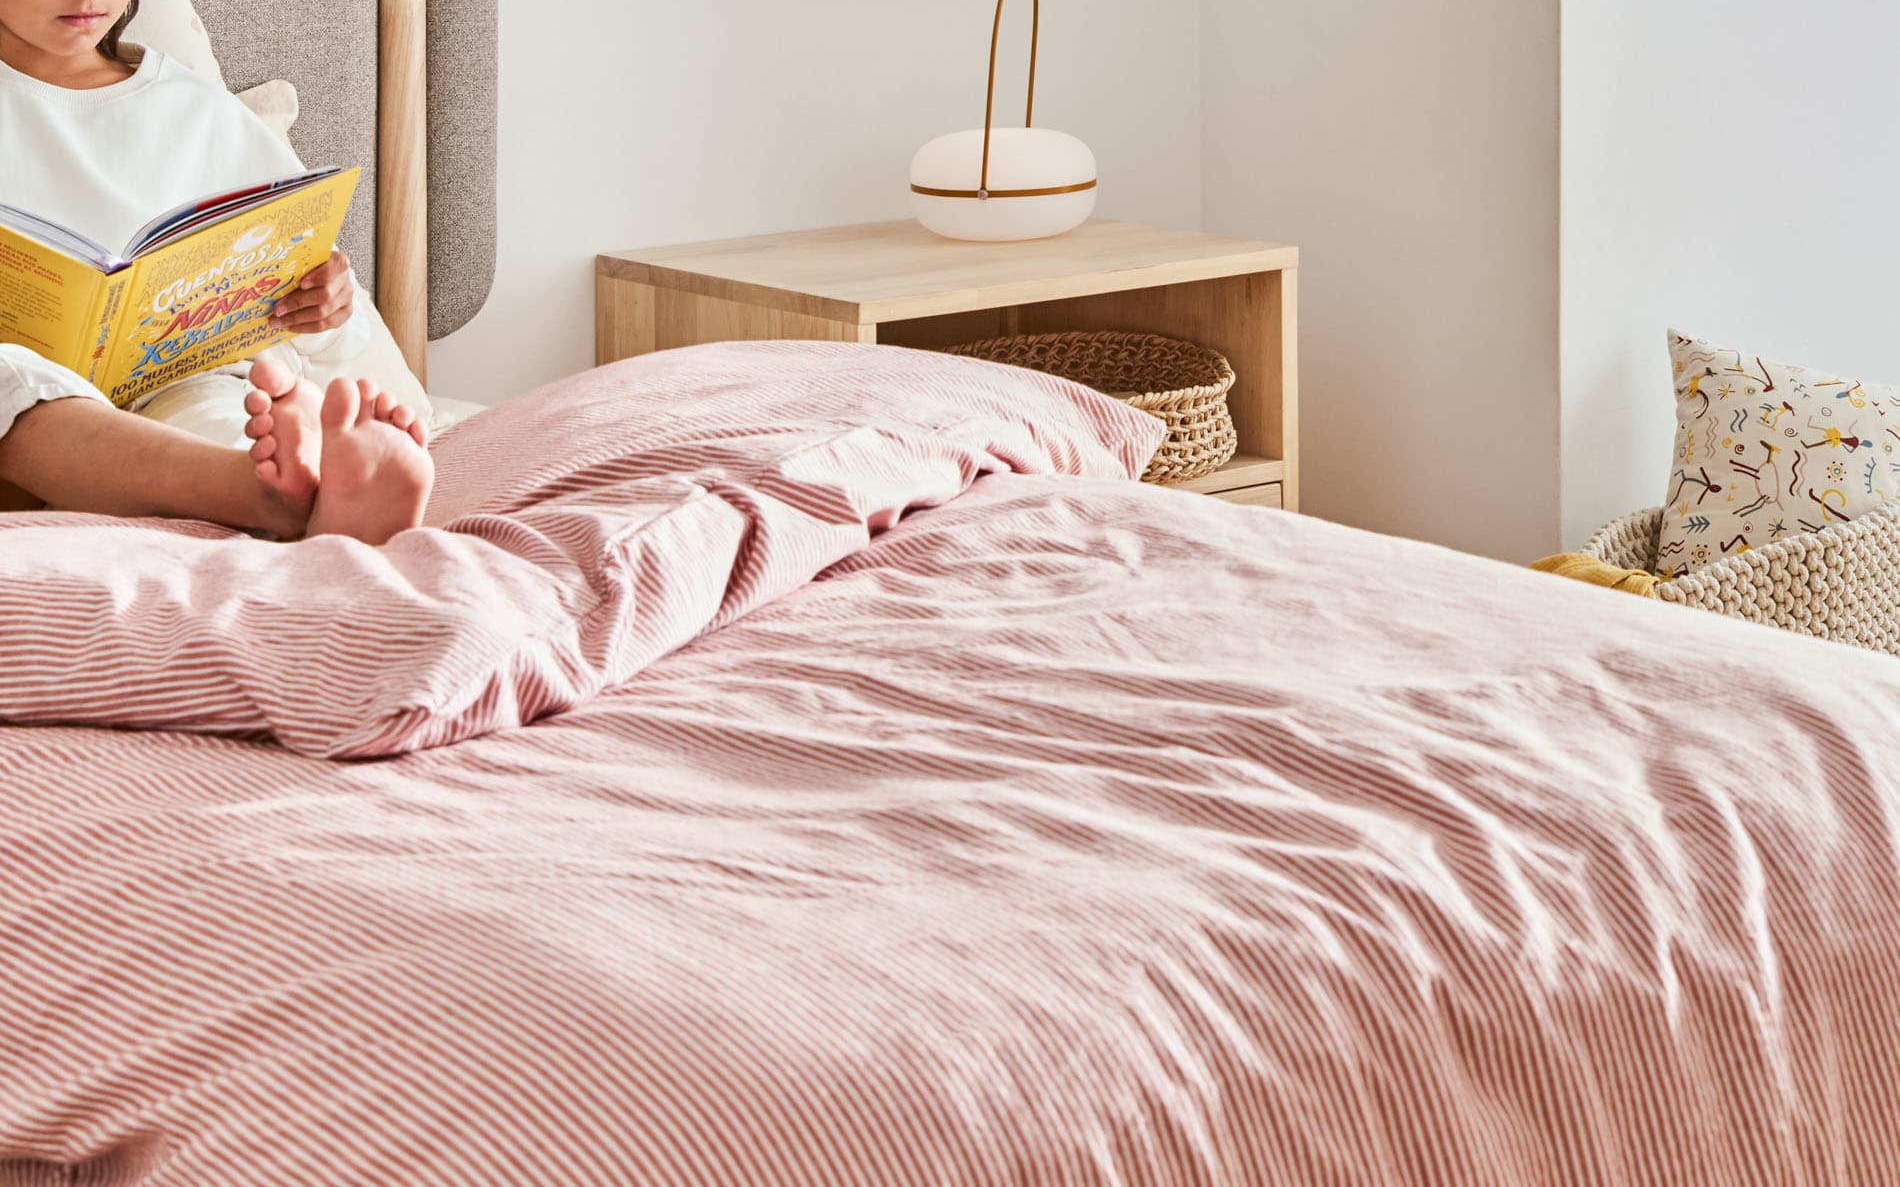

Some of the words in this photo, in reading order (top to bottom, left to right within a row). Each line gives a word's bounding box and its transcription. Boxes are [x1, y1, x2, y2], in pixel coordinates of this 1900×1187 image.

[152, 243, 272, 313] CUENTOS
[266, 241, 295, 262] DE
[152, 274, 281, 345] NIÑAS
[129, 277, 292, 371] REBELDES
[110, 379, 138, 399] 100
[141, 354, 199, 385] MUJERES
[127, 381, 154, 400] HAN
[156, 350, 226, 386] CAMBIADO
